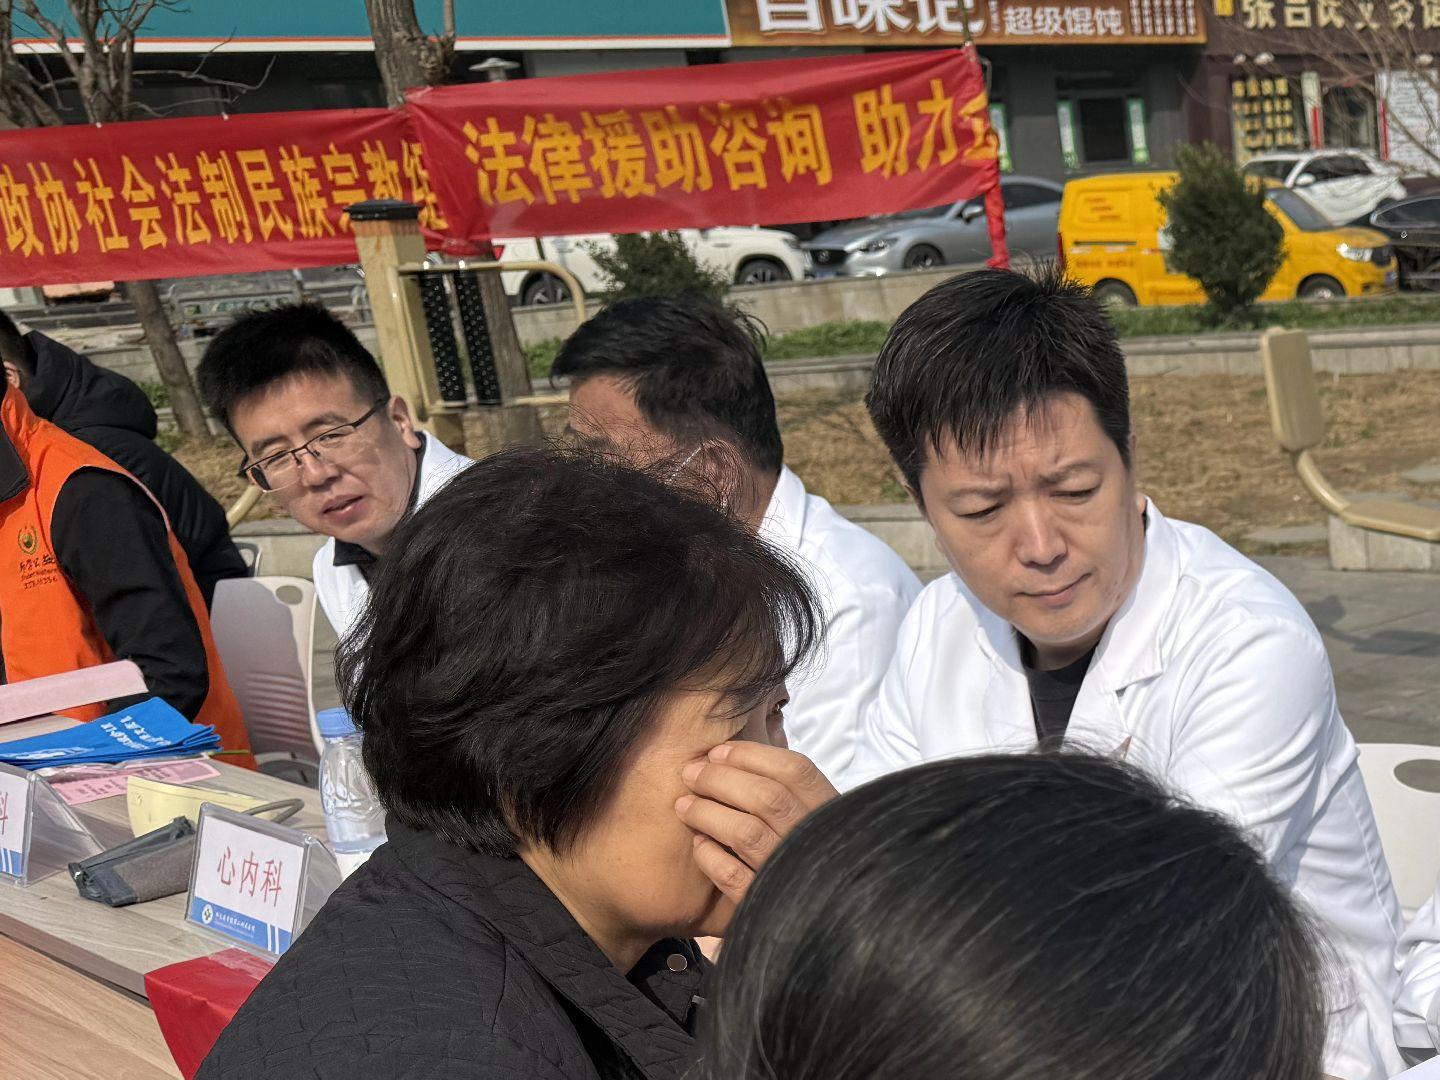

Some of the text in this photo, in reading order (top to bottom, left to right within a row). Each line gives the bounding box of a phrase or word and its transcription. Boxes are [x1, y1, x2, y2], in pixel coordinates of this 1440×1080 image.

[463, 98, 832, 205] 法律援助咨询
[217, 846, 282, 907] 心内科
